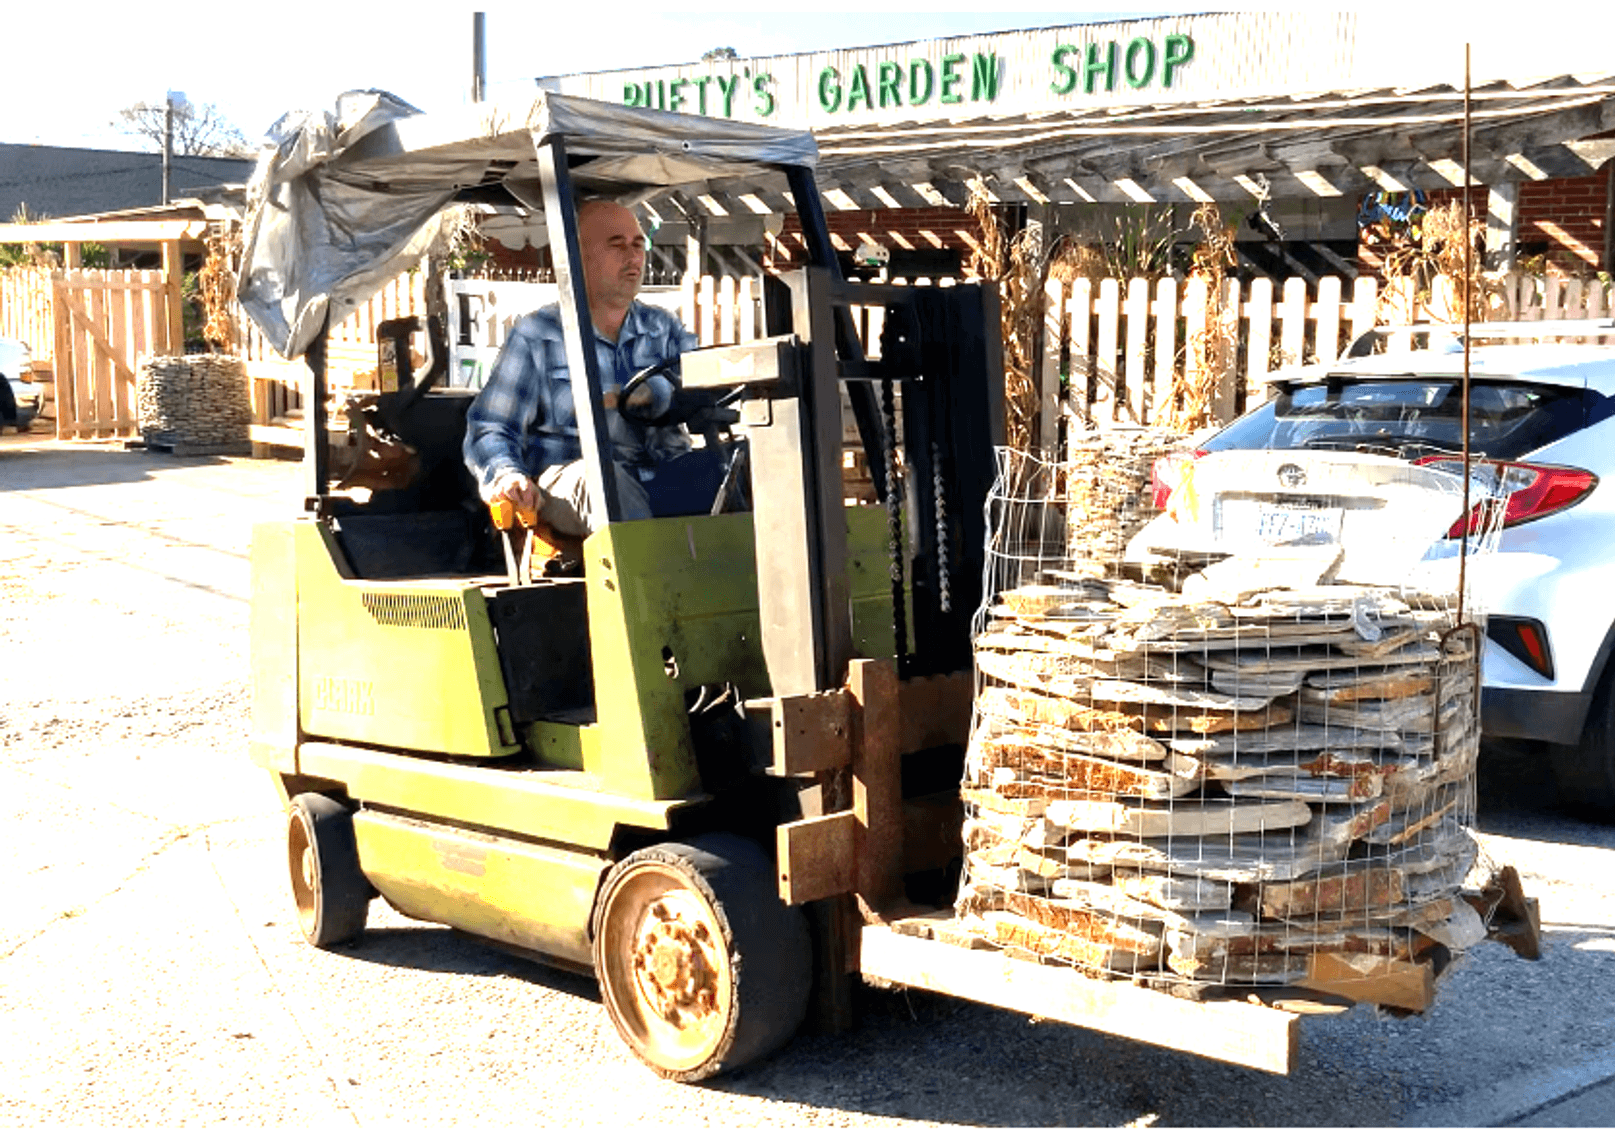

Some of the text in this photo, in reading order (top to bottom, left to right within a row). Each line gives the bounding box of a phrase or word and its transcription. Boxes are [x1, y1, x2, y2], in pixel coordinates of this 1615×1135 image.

[817, 51, 998, 114] GARDEN
[1050, 33, 1196, 95] SHOP
[314, 675, 376, 716] CLARK
